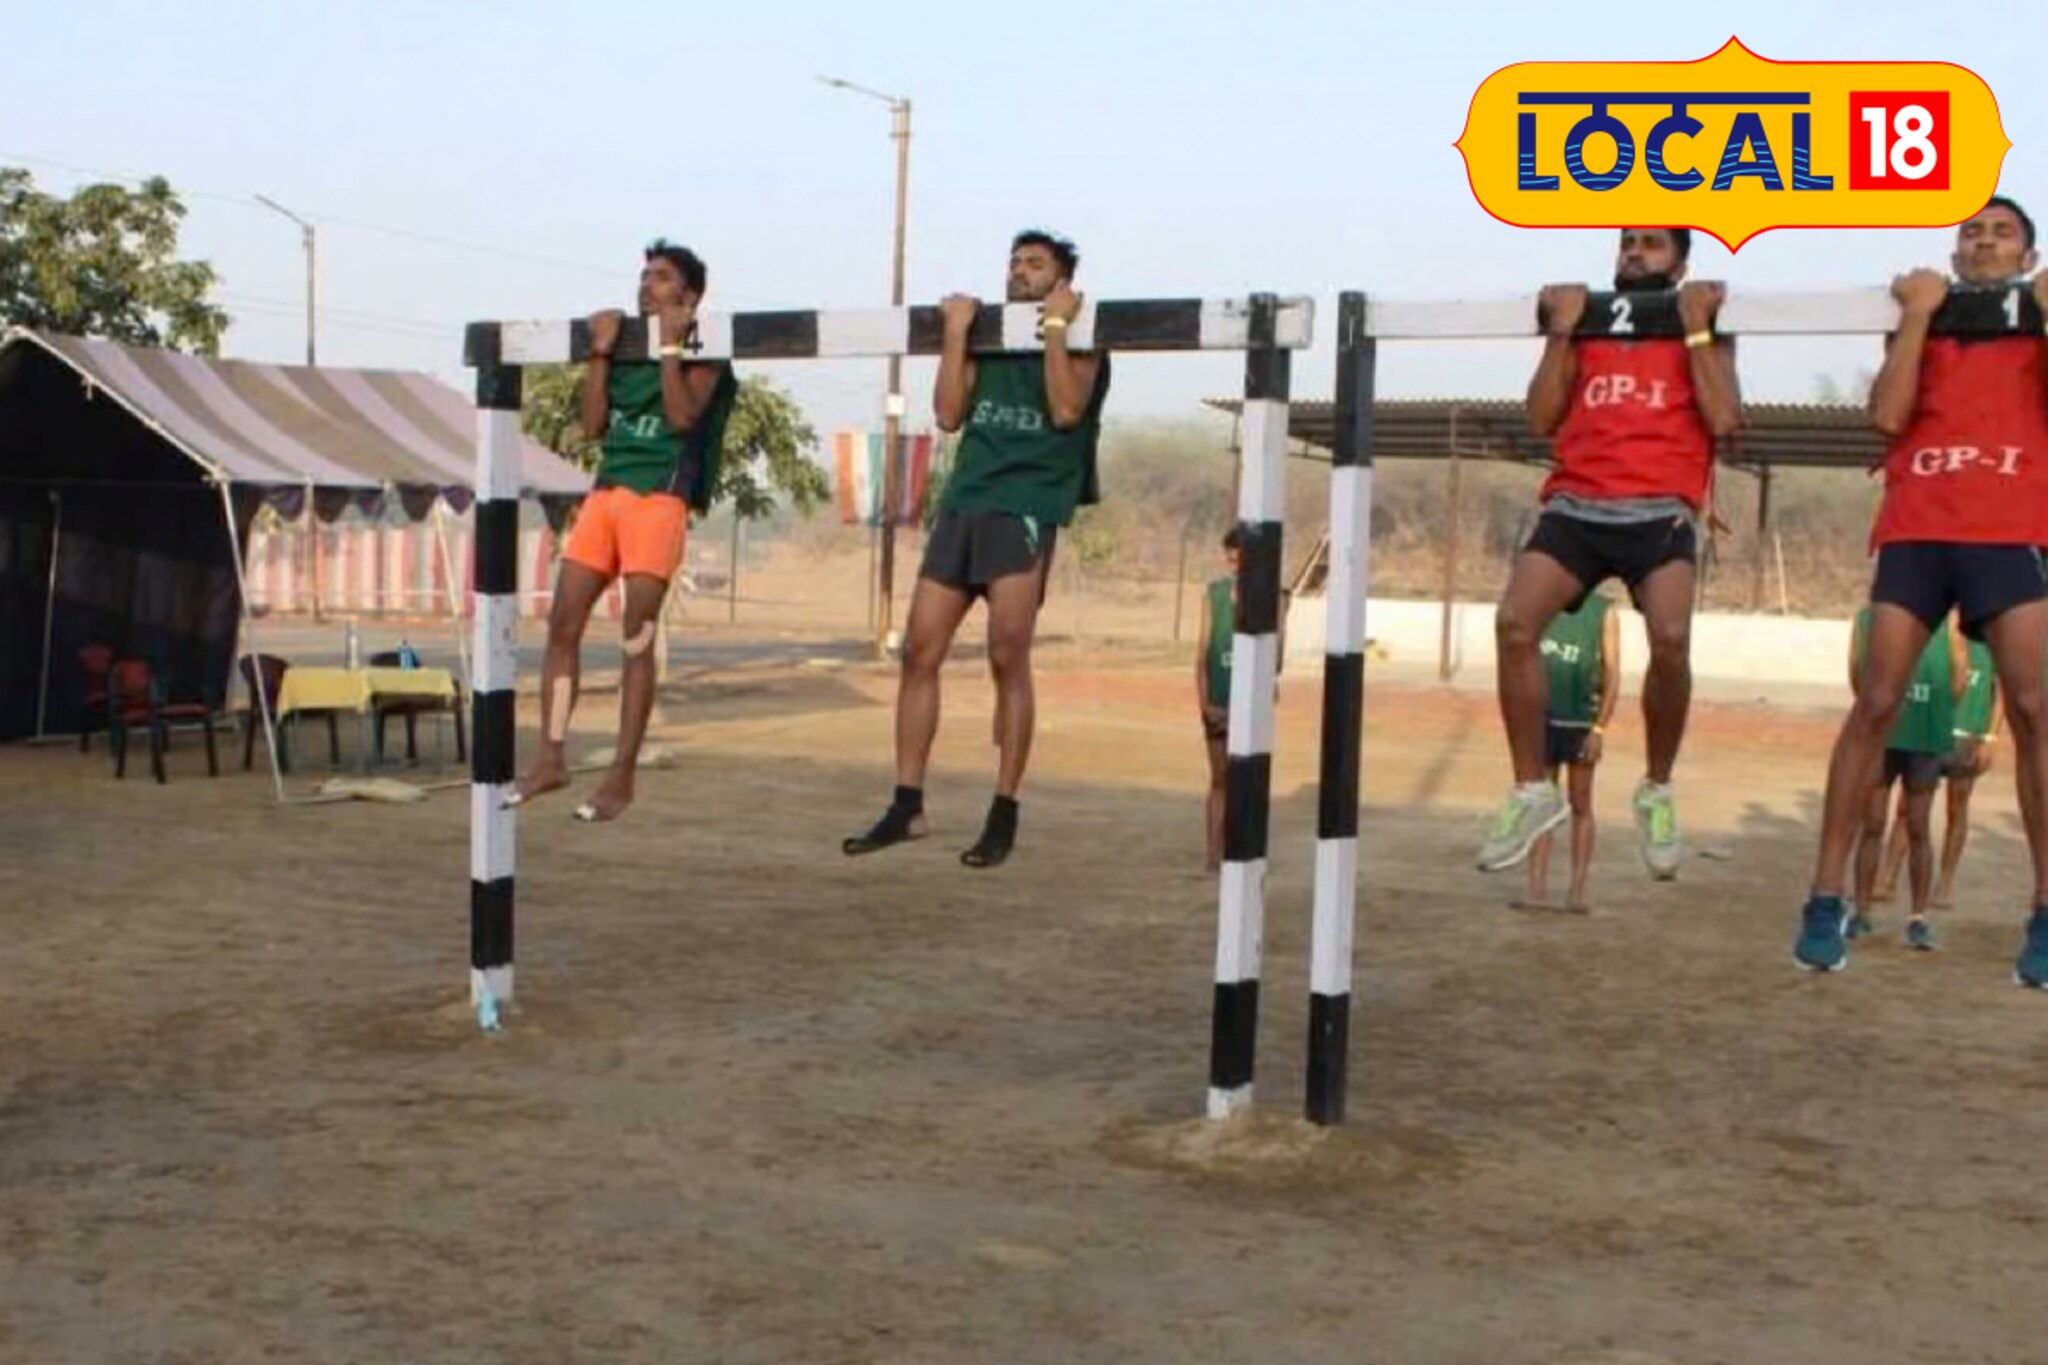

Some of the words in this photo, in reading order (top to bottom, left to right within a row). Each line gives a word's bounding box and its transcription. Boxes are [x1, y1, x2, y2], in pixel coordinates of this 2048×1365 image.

[1609, 298, 1635, 334] 2
[2002, 288, 2020, 328] 1
[1584, 374, 1667, 409] GP-I
[1911, 446, 2023, 476] GP-I
